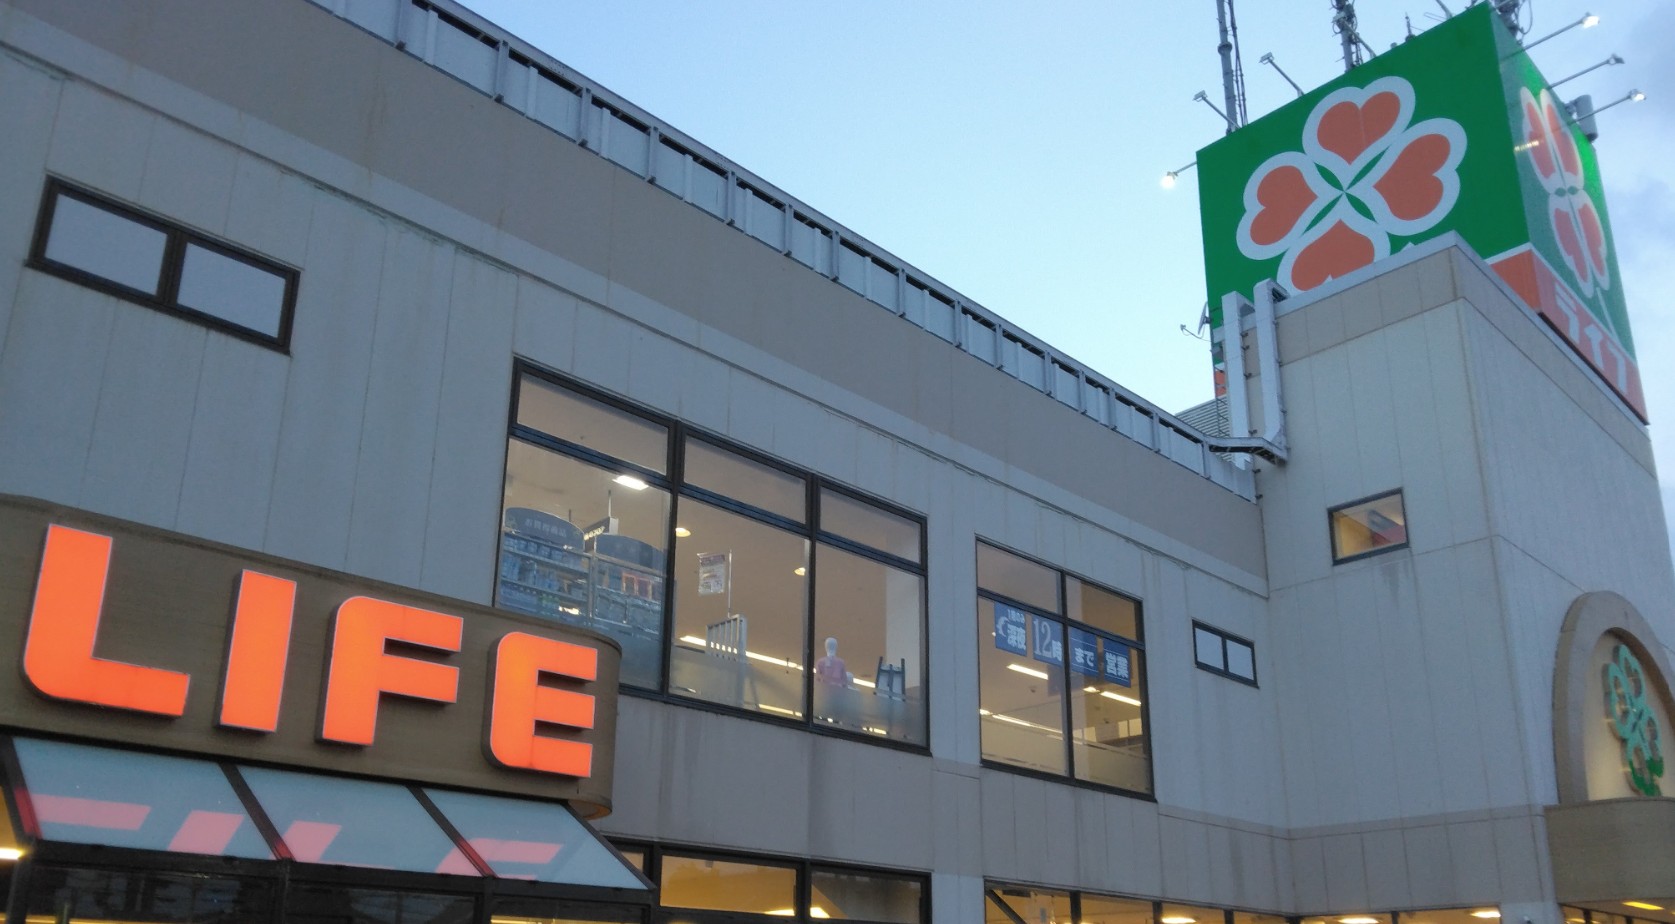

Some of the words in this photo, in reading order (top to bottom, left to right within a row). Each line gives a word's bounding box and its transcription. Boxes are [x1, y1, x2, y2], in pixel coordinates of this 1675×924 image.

[1555, 281, 1627, 394] ライフ
[23, 524, 597, 778] LIFE
